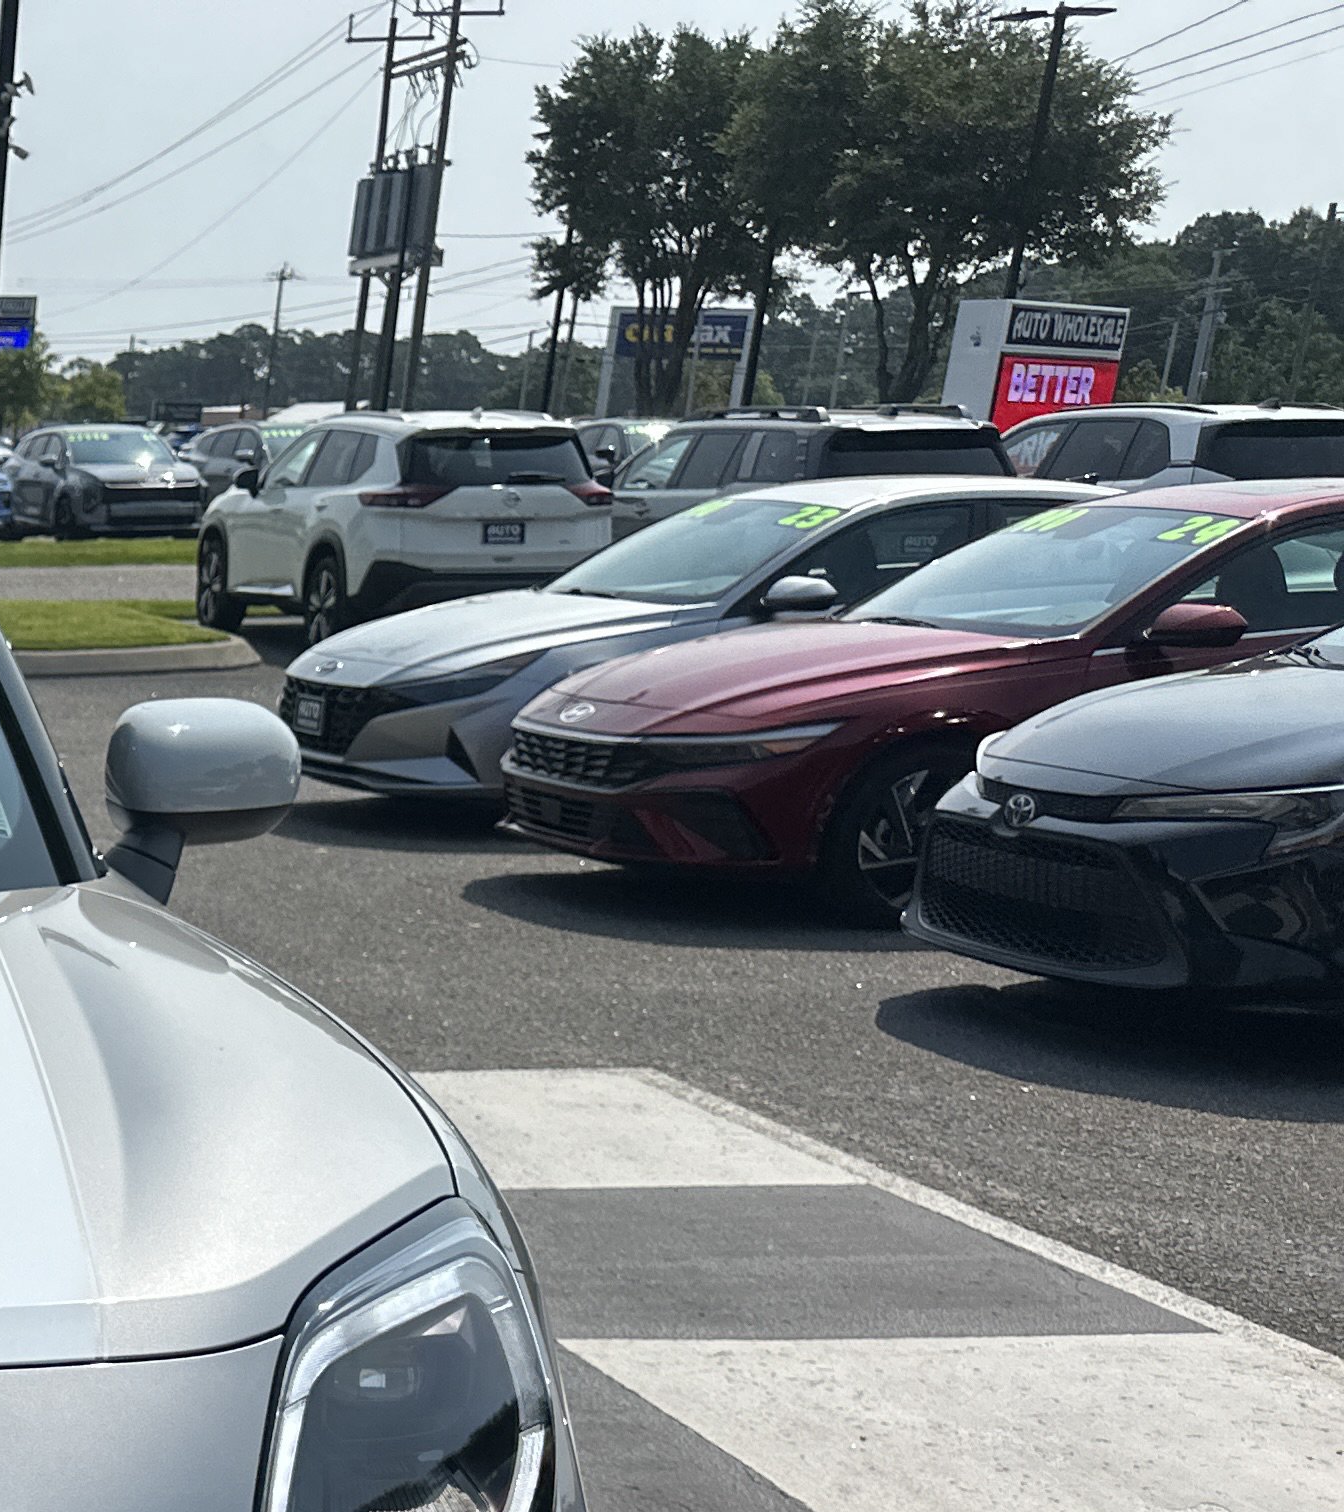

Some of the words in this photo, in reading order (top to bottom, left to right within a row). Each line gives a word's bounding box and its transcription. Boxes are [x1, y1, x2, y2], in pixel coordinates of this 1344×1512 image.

[1012, 311, 1051, 340] AUTO
[1052, 314, 1124, 345] WHOLESALE
[1007, 362, 1096, 405] BETTER
[776, 504, 842, 530] 23
